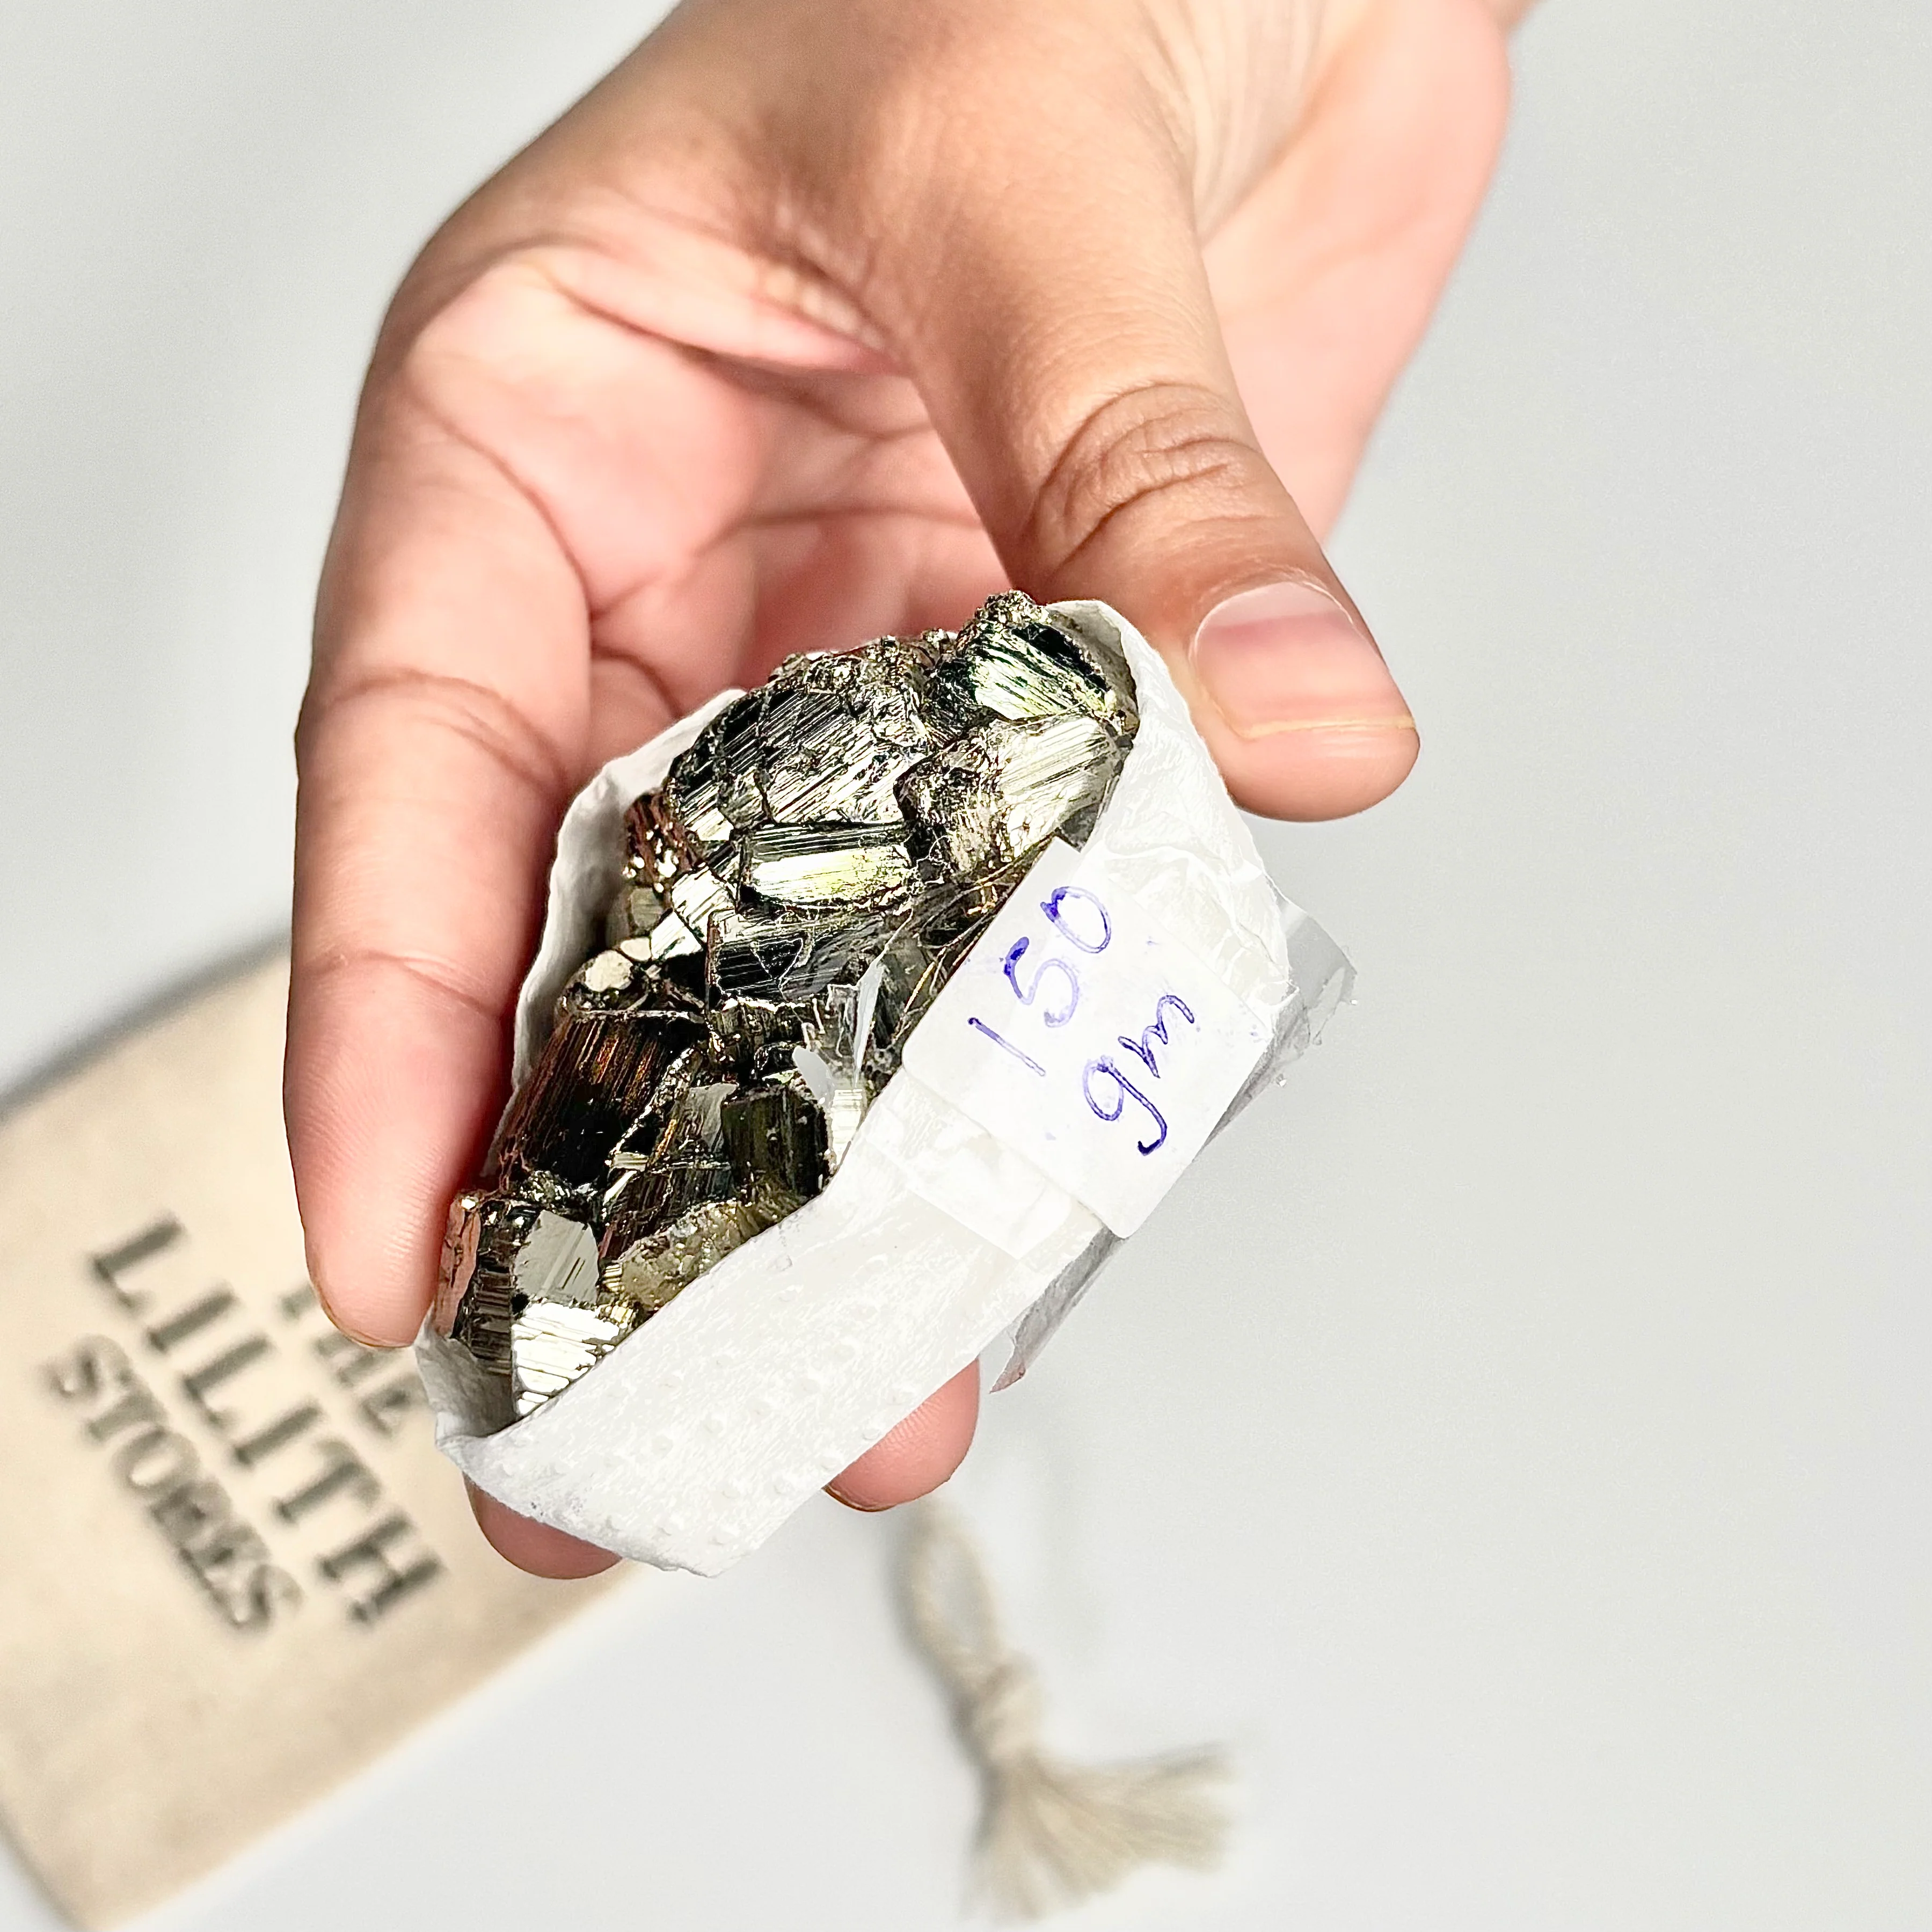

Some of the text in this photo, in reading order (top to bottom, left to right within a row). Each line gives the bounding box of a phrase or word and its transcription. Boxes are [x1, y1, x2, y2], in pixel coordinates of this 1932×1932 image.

[967, 886, 1112, 1077] 150
[1082, 994, 1195, 1156] gm
[89, 1211, 446, 1629] LILITH
